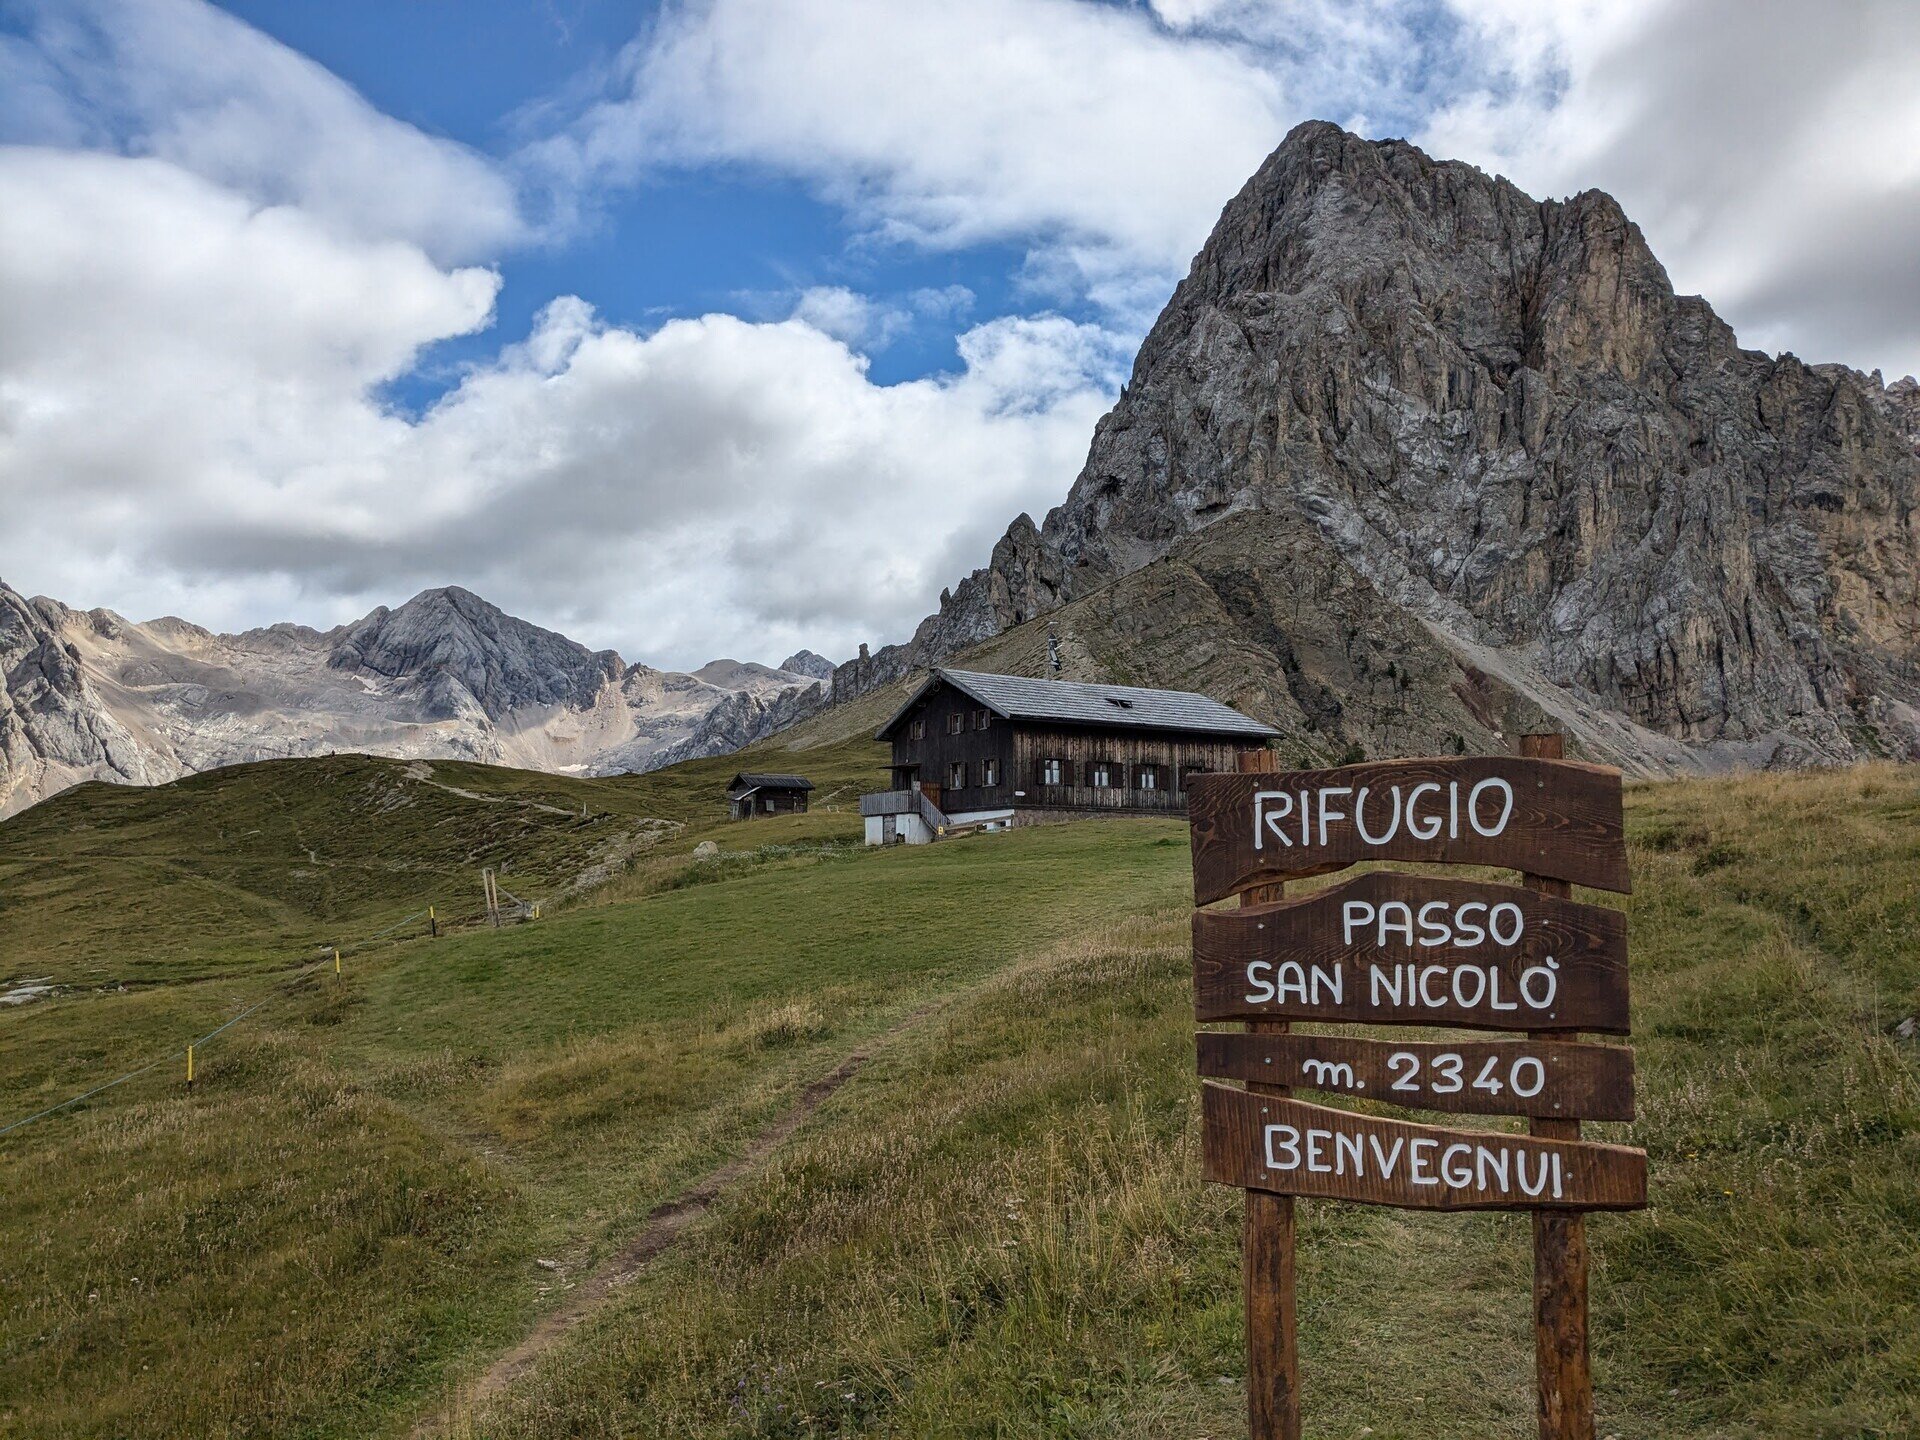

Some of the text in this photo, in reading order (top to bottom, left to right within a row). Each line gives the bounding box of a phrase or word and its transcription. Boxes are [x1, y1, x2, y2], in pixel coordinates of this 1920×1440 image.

[1254, 777, 1513, 850] RIFUGIO
[1343, 900, 1524, 947] PASSO
[1245, 955, 1560, 1010] SAN NICOLÒ
[1302, 1051, 1545, 1098] m. 2340
[1264, 1124, 1563, 1199] BENVEGNUI
